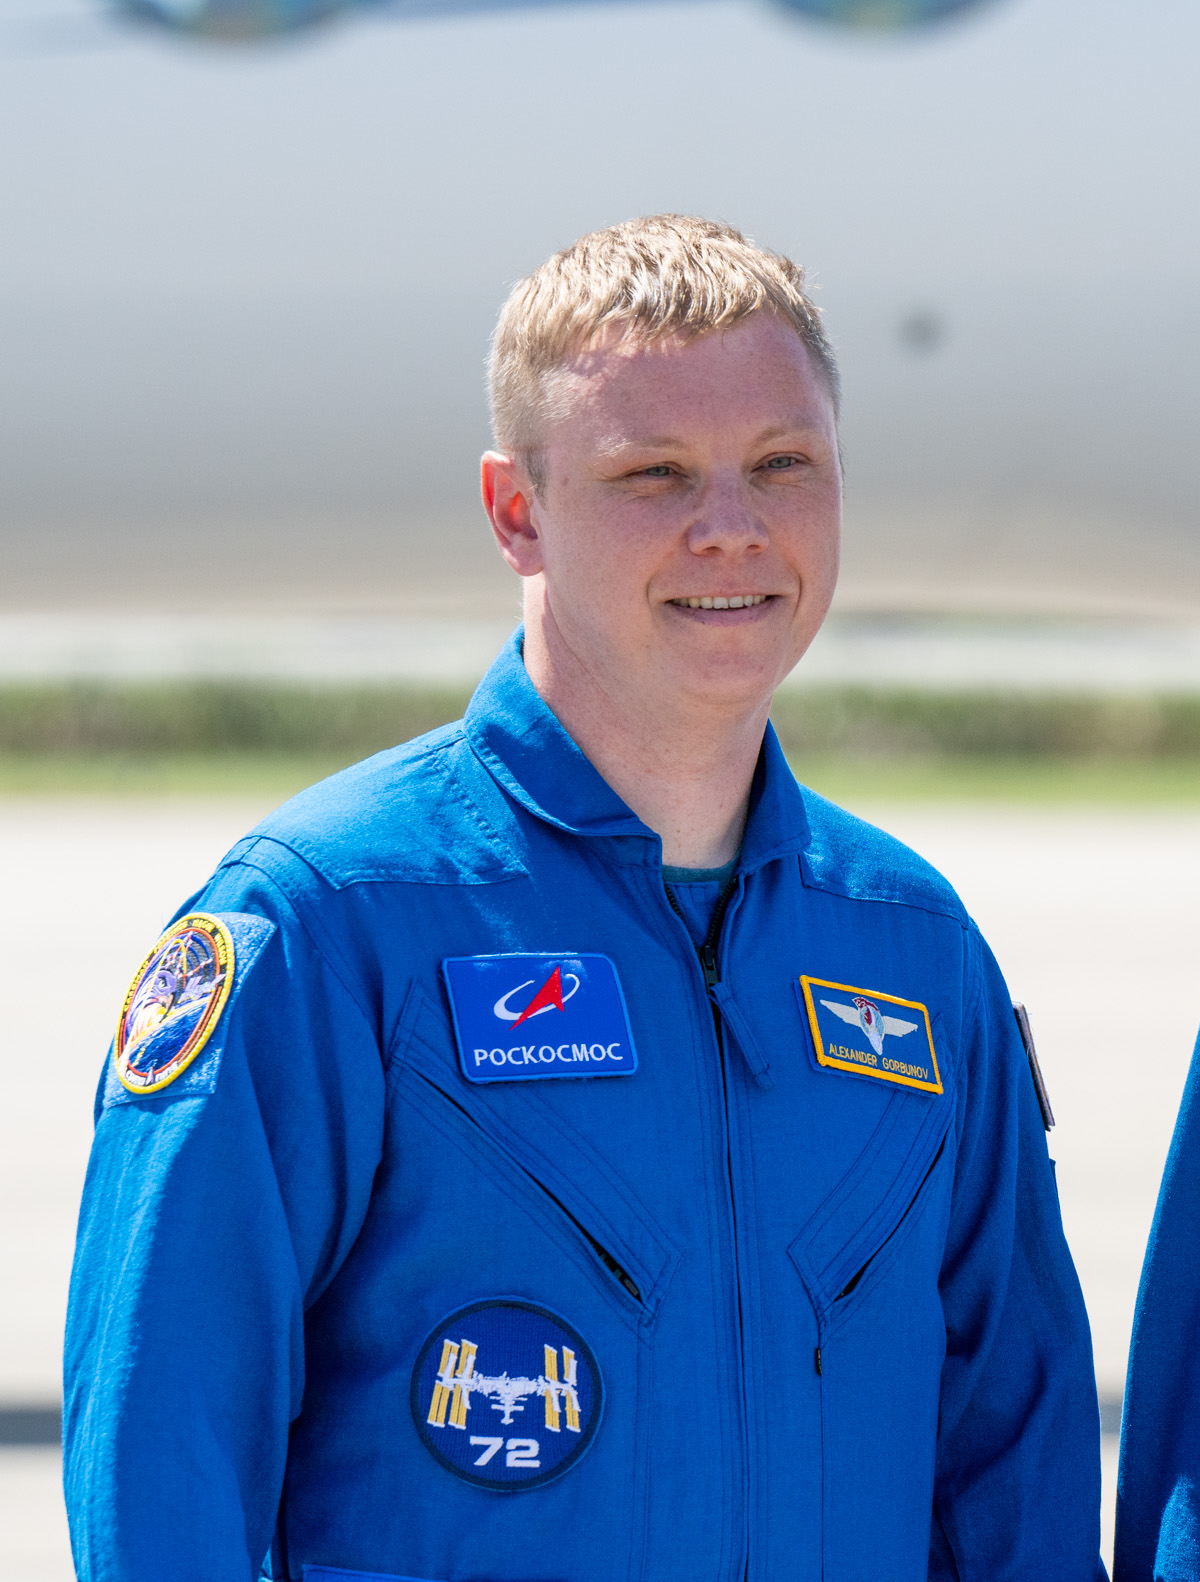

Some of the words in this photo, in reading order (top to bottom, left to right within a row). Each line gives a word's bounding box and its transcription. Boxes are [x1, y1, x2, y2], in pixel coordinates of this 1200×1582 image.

[473, 1043, 623, 1066] РОСКОСМОС
[829, 1043, 878, 1067] ALEXANDER
[882, 1057, 929, 1080] GORBUNOV
[469, 1435, 541, 1468] 72
